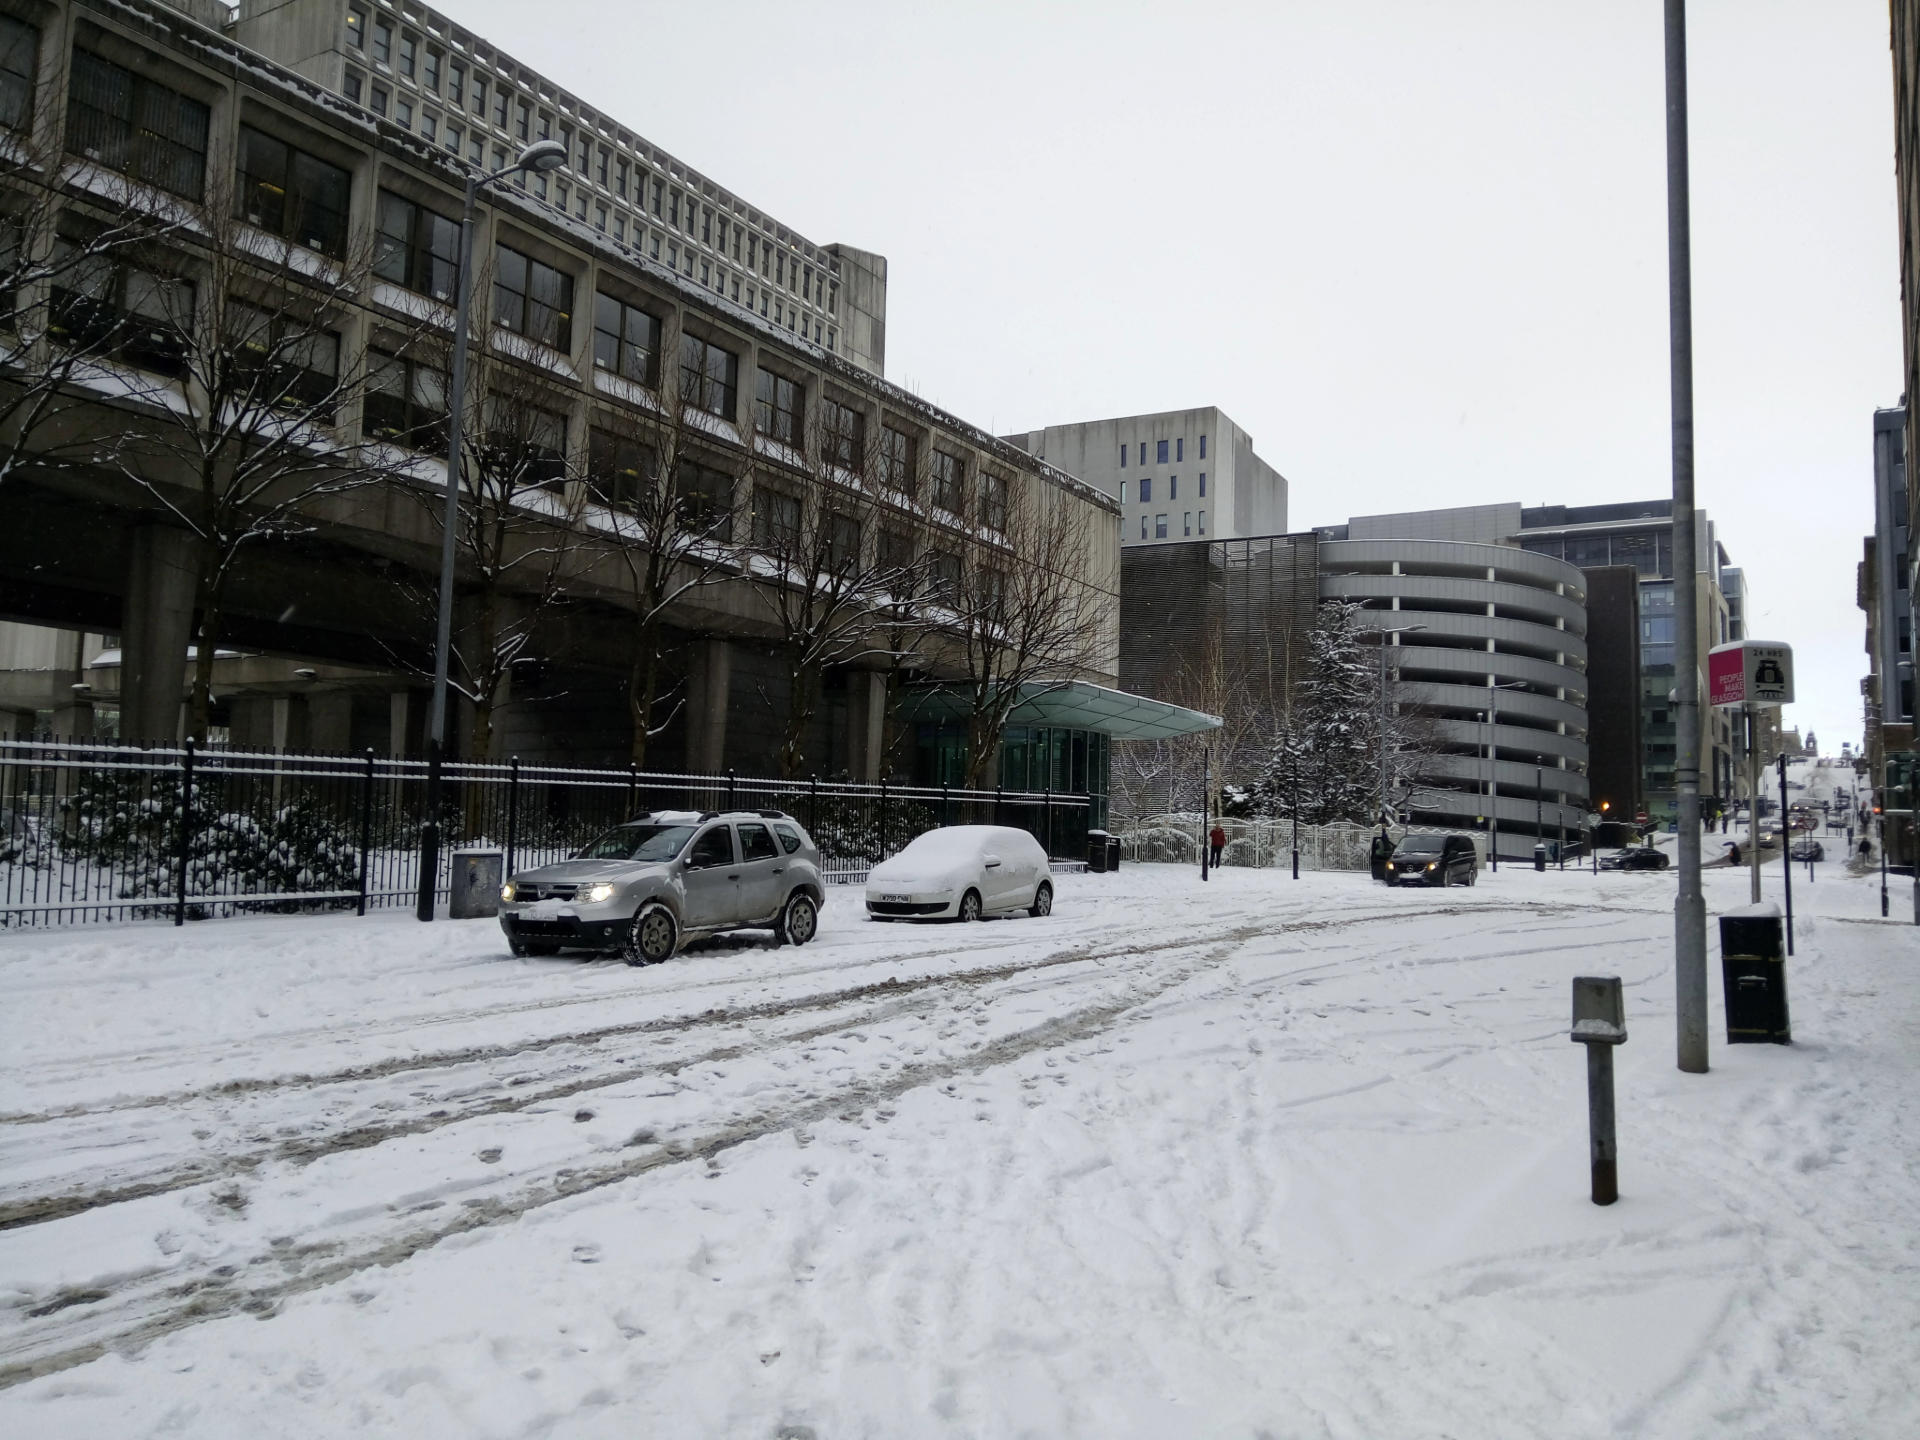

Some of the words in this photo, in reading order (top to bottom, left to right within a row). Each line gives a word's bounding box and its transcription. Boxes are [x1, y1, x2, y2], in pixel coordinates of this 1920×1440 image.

[1753, 648, 1763, 656] 24
[1719, 672, 1744, 684] PEOPLE
[1724, 681, 1744, 692] MAKE
[1711, 690, 1744, 704] GLASGOW
